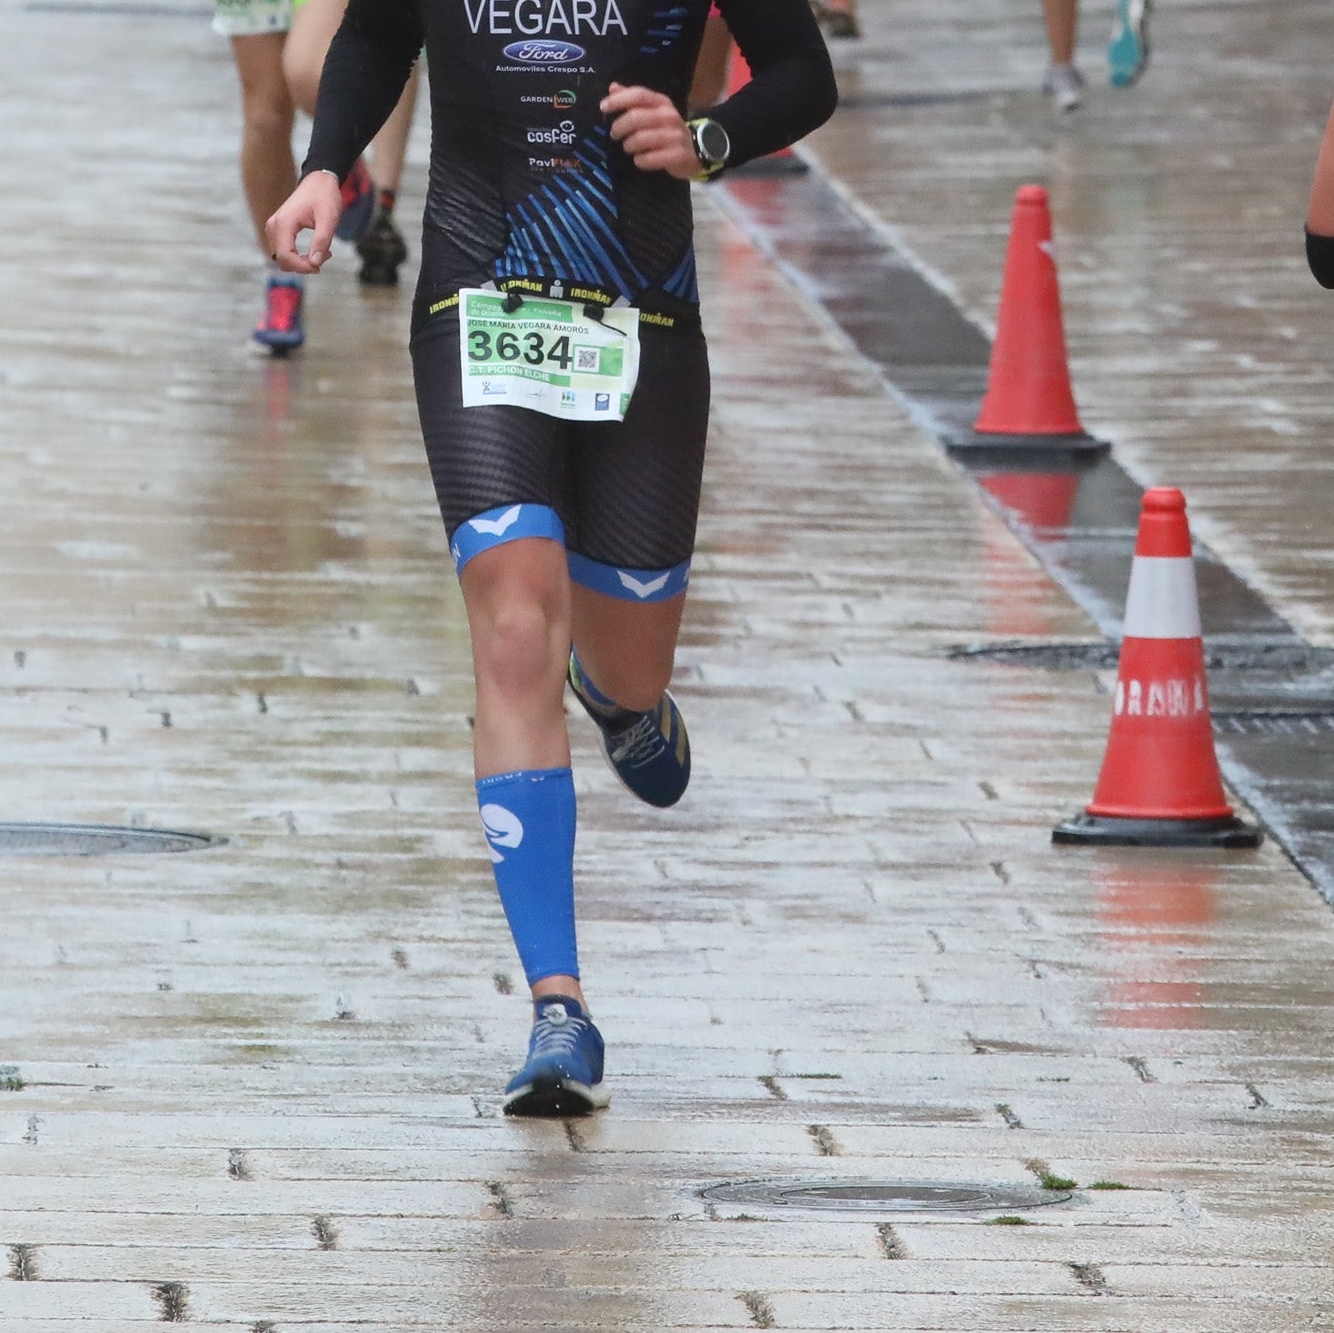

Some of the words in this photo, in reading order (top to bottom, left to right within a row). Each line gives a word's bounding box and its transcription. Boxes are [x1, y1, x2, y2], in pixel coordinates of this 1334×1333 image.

[518, 42, 571, 61] Ford
[548, 66, 577, 74] Crespo
[527, 129, 577, 145] cosfer
[429, 293, 460, 315] IRONM
[571, 288, 612, 305] IRONMAN
[639, 312, 674, 328] ONMAN
[518, 322, 551, 330] VEGARA
[553, 325, 589, 335] AMORÓS
[468, 330, 572, 370] 3634
[487, 366, 523, 375] PICHON
[525, 369, 551, 382] ELCHE
